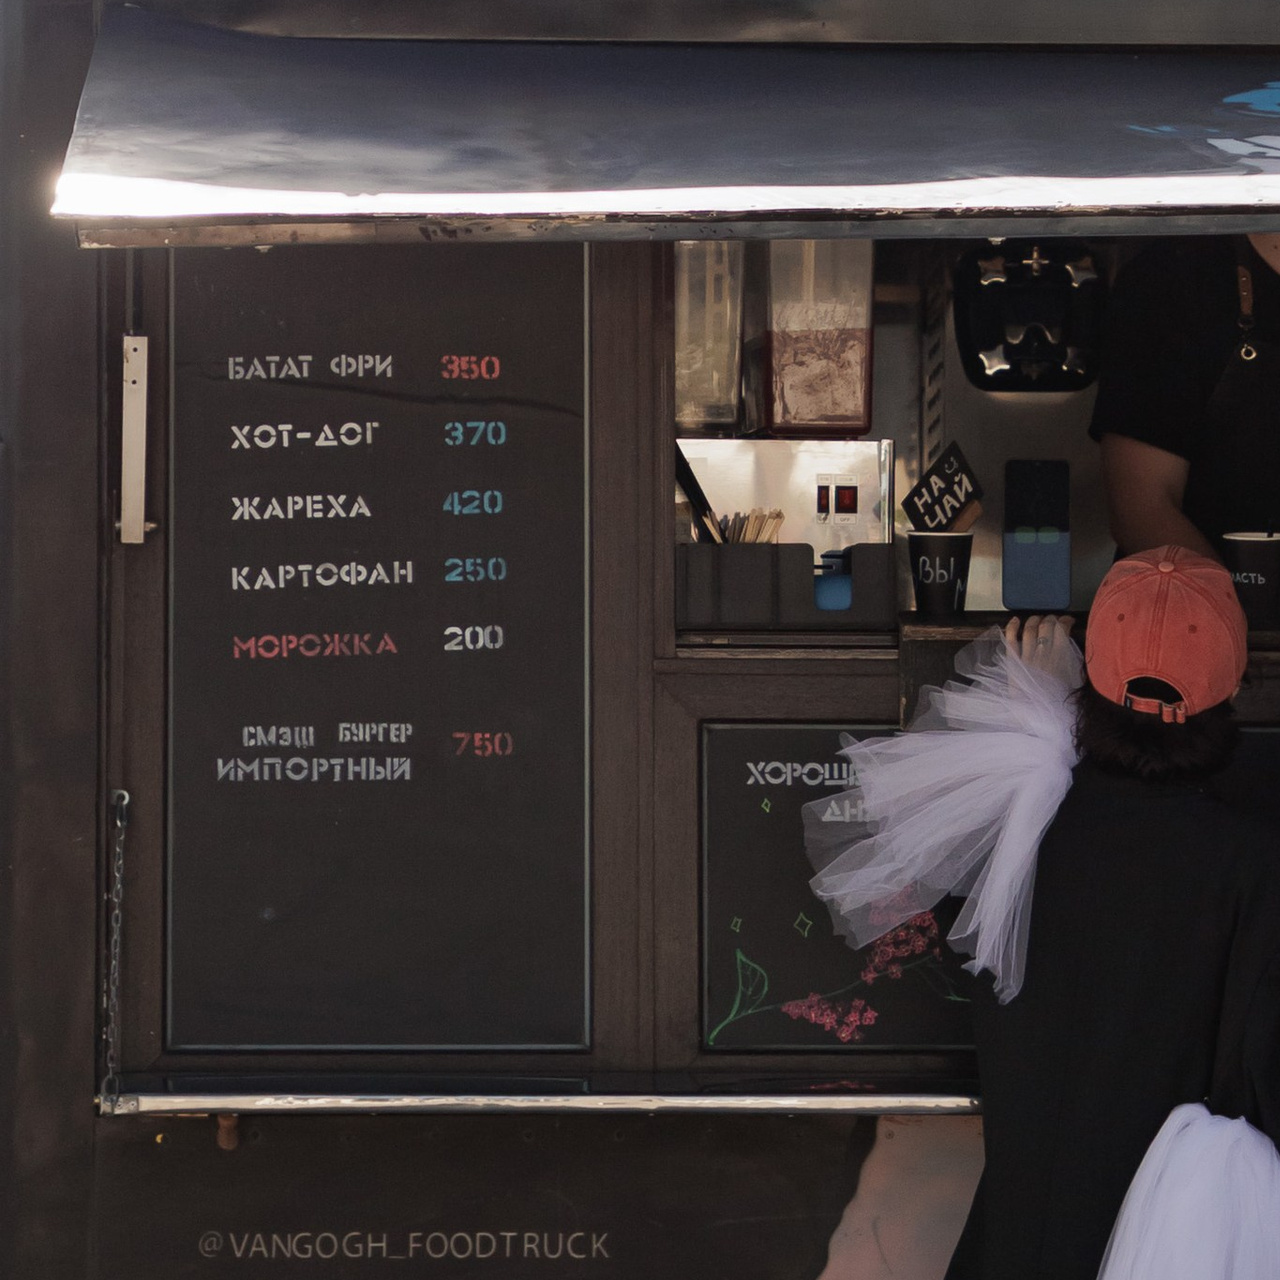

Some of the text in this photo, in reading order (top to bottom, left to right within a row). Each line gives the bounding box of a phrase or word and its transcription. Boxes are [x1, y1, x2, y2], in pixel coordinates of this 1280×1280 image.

[229, 354, 500, 379] БАТАТ ФРИ 350
[231, 421, 506, 449] ХОТ-ДОГ 370
[232, 490, 502, 520] ЖАРЕХА 420
[914, 475, 945, 513] НА
[924, 472, 973, 528] ЧАЙ
[232, 558, 506, 590] КАРТОФАН 250
[919, 556, 954, 583] ВЫ
[1231, 572, 1267, 585] АСТЬ
[234, 626, 503, 658] МОРОЖКА 200
[243, 723, 514, 757] СМЭШ БУРГЕР 750
[217, 757, 410, 781] ИМПОРТНЫЙ
[199, 1231, 608, 1259] @VANGOGH_FOODTRUCK
